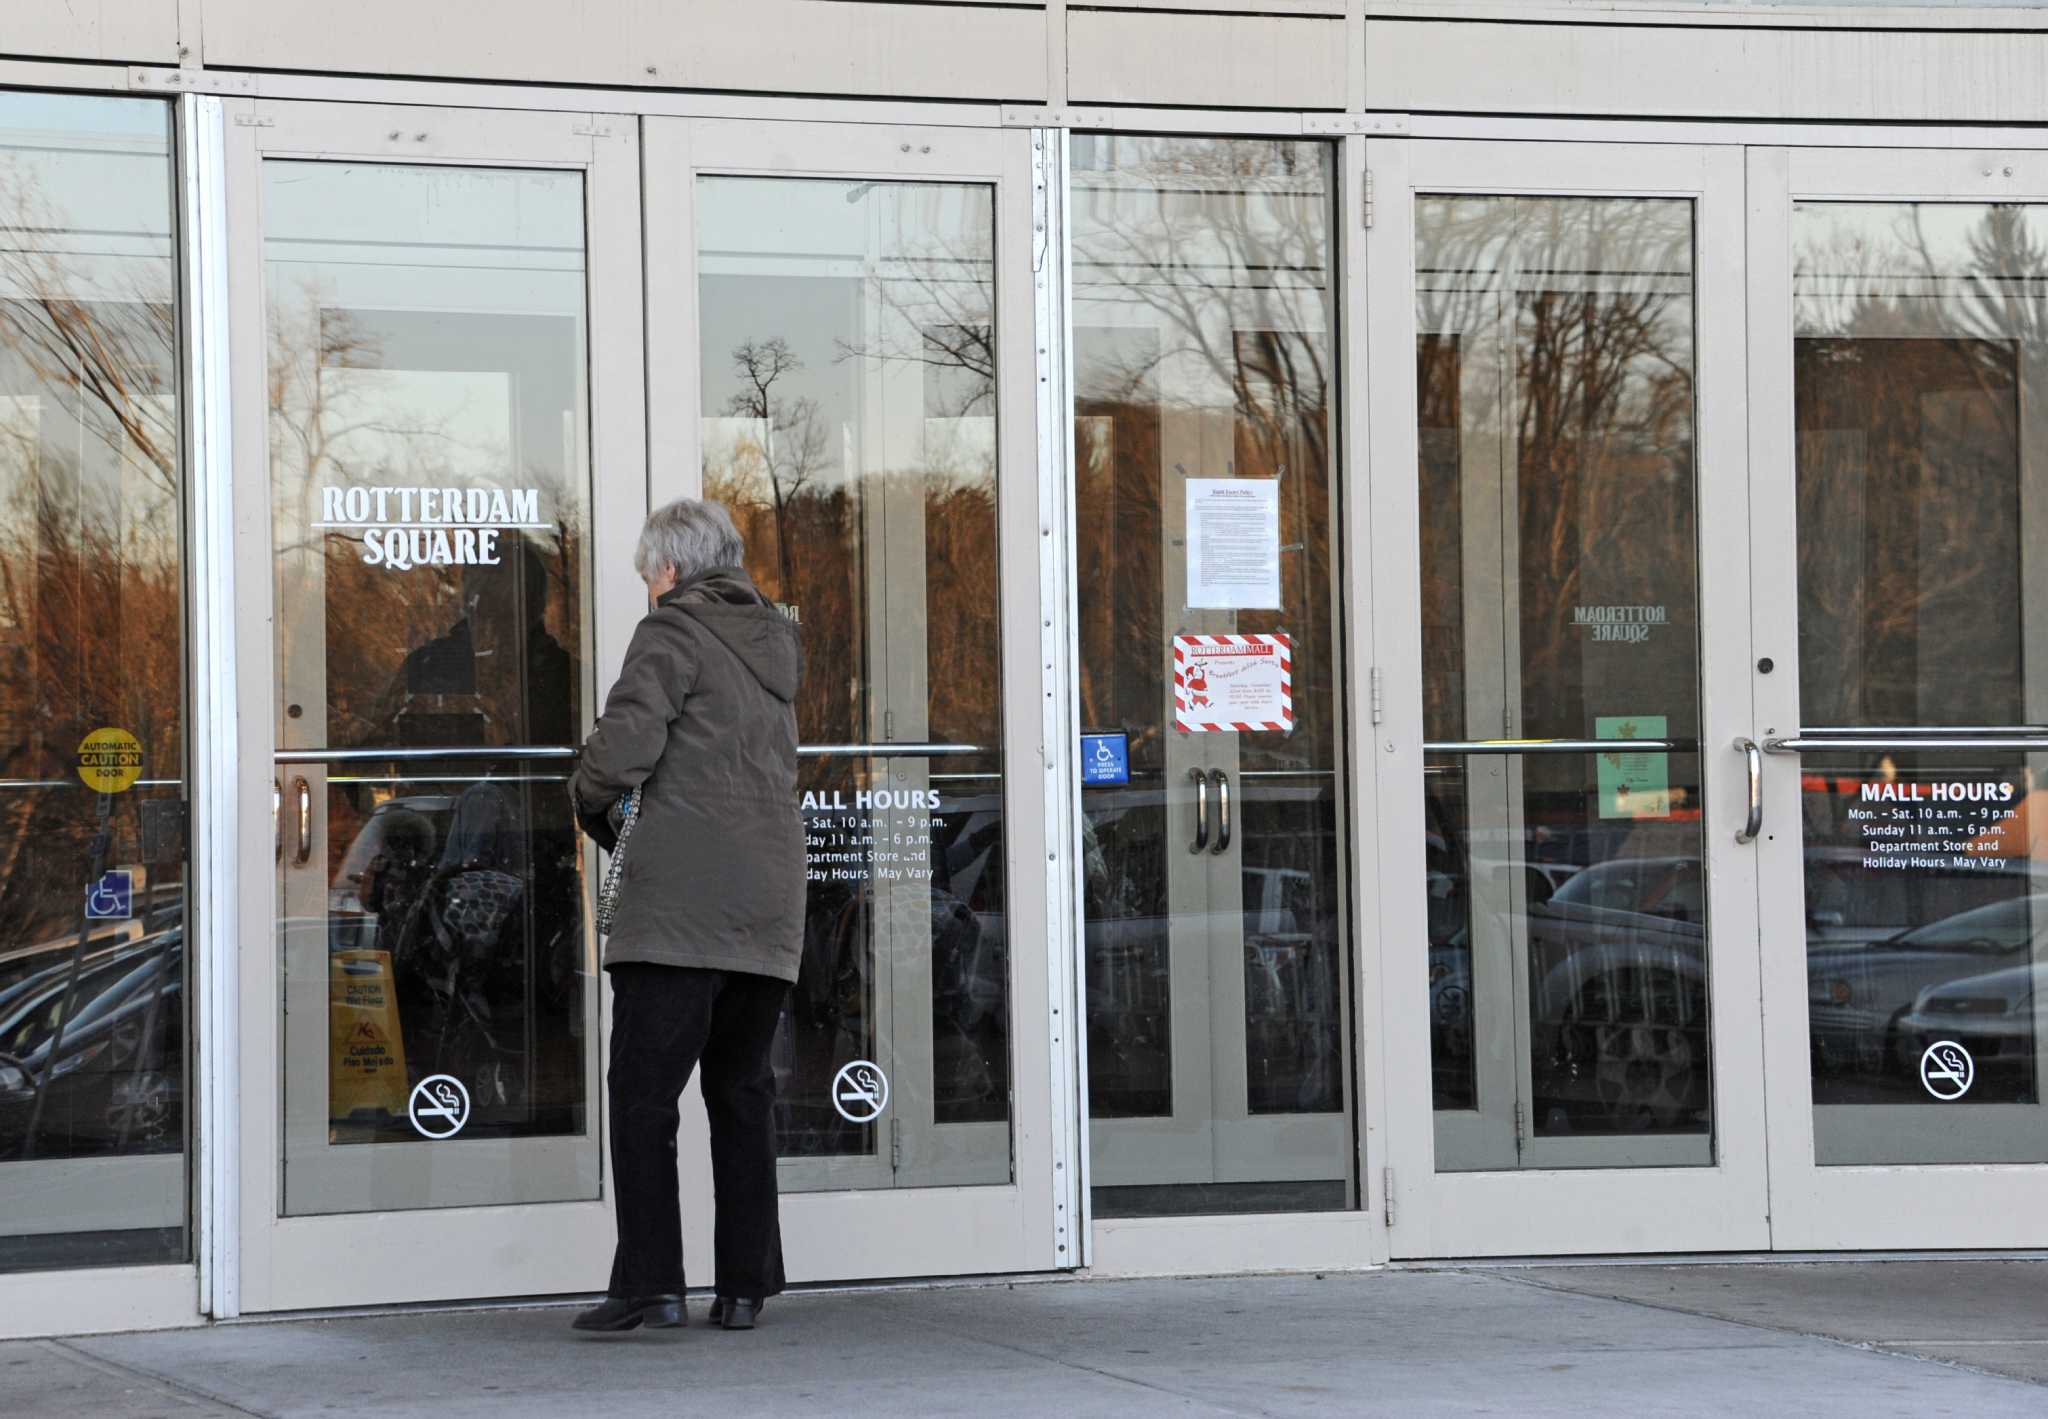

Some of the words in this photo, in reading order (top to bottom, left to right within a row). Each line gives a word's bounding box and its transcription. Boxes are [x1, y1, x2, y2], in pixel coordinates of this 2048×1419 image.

[322, 486, 540, 523] ROTTERDAM
[363, 528, 500, 571] SQUARE
[83, 743, 137, 751] AUTOMATIC
[81, 754, 139, 766] CAUTION
[96, 768, 124, 777] DOOR
[1861, 783, 1924, 801] MALL
[1932, 782, 2014, 801] HOURS
[801, 789, 847, 810] ALL
[856, 789, 941, 810] HOURS
[1848, 809, 1877, 820] Mon.
[1892, 808, 1914, 819] Sat.
[1919, 808, 1932, 819] 10
[1936, 810, 1962, 819] a.m.
[1980, 808, 1988, 819] 9
[1992, 809, 2018, 820] p.m.
[812, 817, 836, 829] Sat.
[841, 817, 856, 828] 10
[861, 818, 887, 828] a.m.
[907, 816, 915, 828] 9
[920, 818, 948, 830] p.m.
[1862, 825, 1904, 837] Sunday
[1910, 824, 1921, 835] 11
[1927, 826, 1953, 835] a.m.
[1968, 824, 1975, 835] 6
[1979, 826, 2005, 837] p.m.
[805, 834, 826, 847] day
[831, 834, 844, 845] 11
[850, 836, 878, 845] a.m.
[894, 833, 901, 844] 6
[906, 835, 933, 847] p.m.
[1870, 841, 1939, 853] Department
[1943, 840, 1973, 851] Store
[1977, 840, 1999, 851] and
[806, 851, 863, 865] partment
[867, 850, 898, 862] Store
[1863, 857, 1907, 869] Holiday
[1911, 857, 1945, 868] Hours
[1953, 857, 1977, 869] May
[1980, 857, 2006, 869] Vary
[832, 868, 869, 880] Hours
[878, 868, 901, 881] May
[906, 868, 934, 881] Vary
[346, 985, 382, 994] CAUTION
